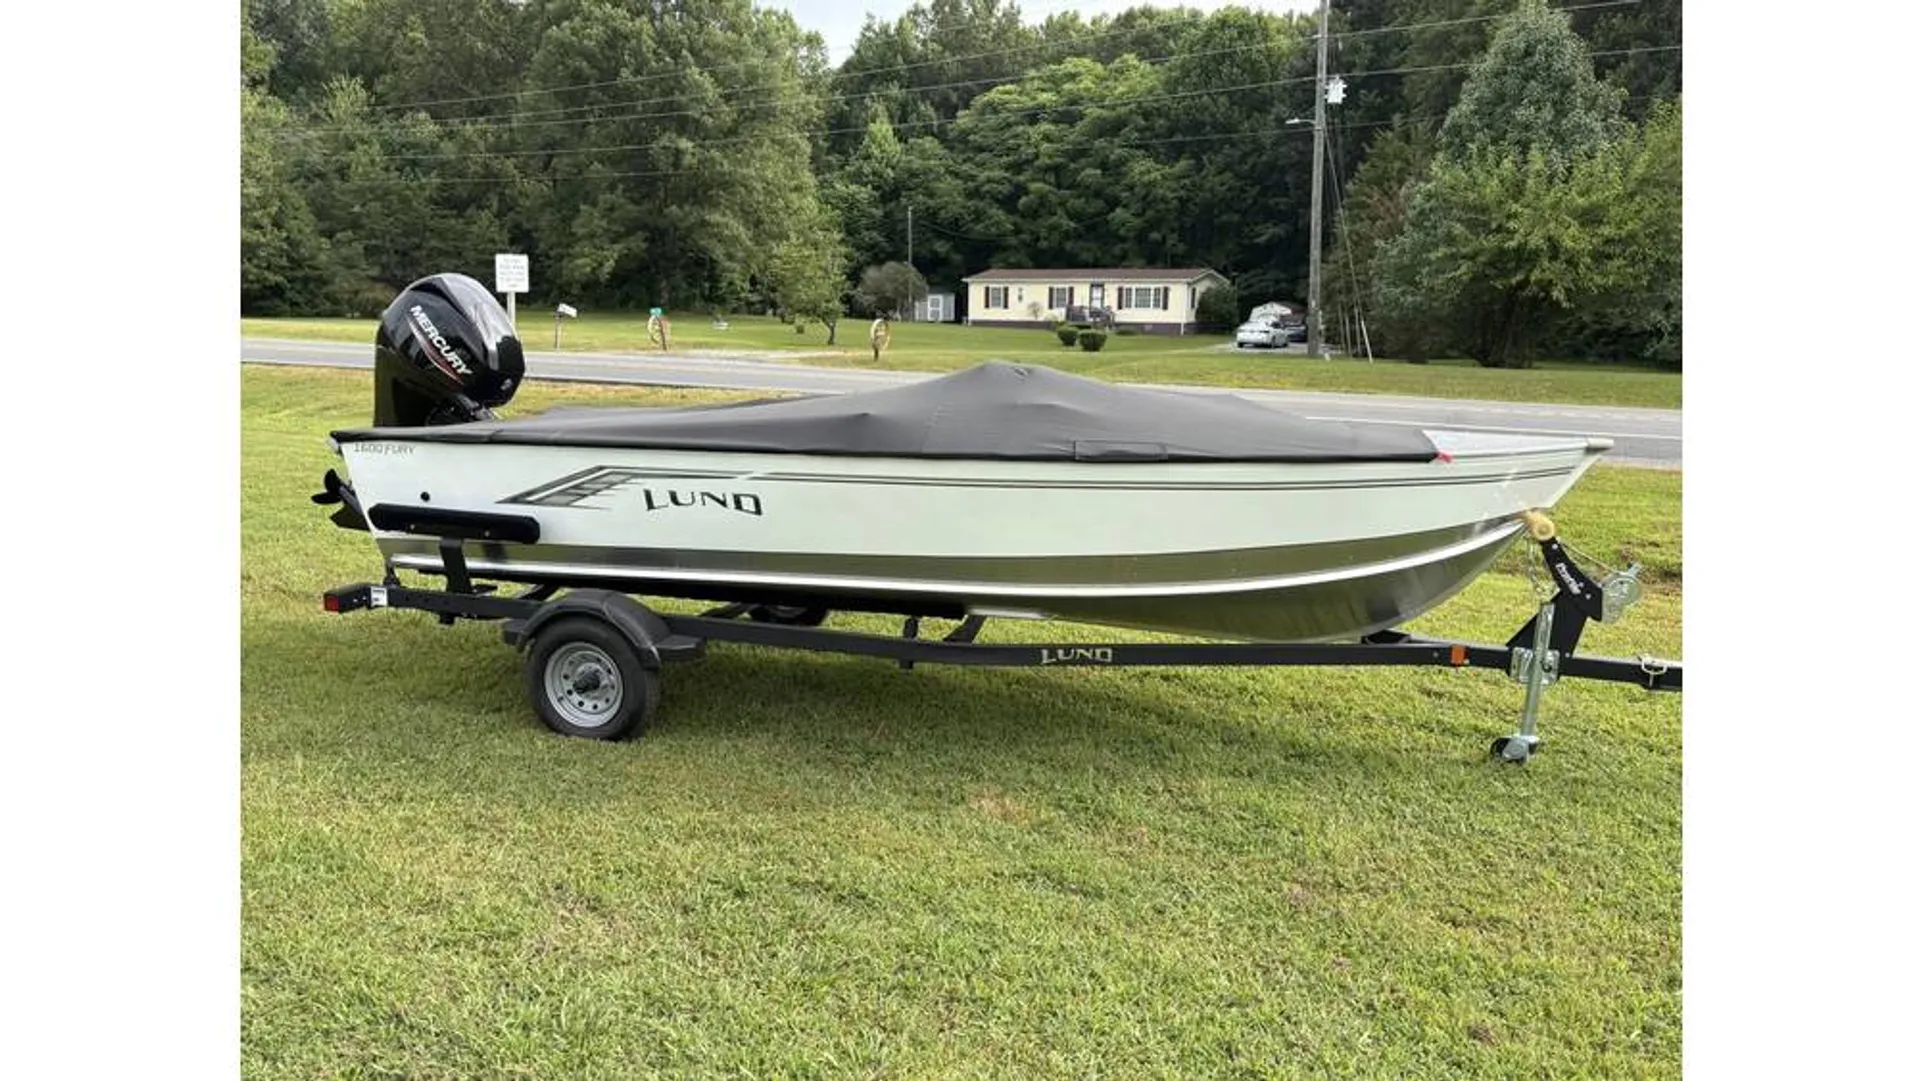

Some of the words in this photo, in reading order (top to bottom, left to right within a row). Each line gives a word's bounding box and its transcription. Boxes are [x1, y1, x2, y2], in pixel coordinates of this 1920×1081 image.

[410, 305, 473, 374] MERCURY
[643, 489, 763, 516] LUND
[1041, 648, 1112, 664] LUND
